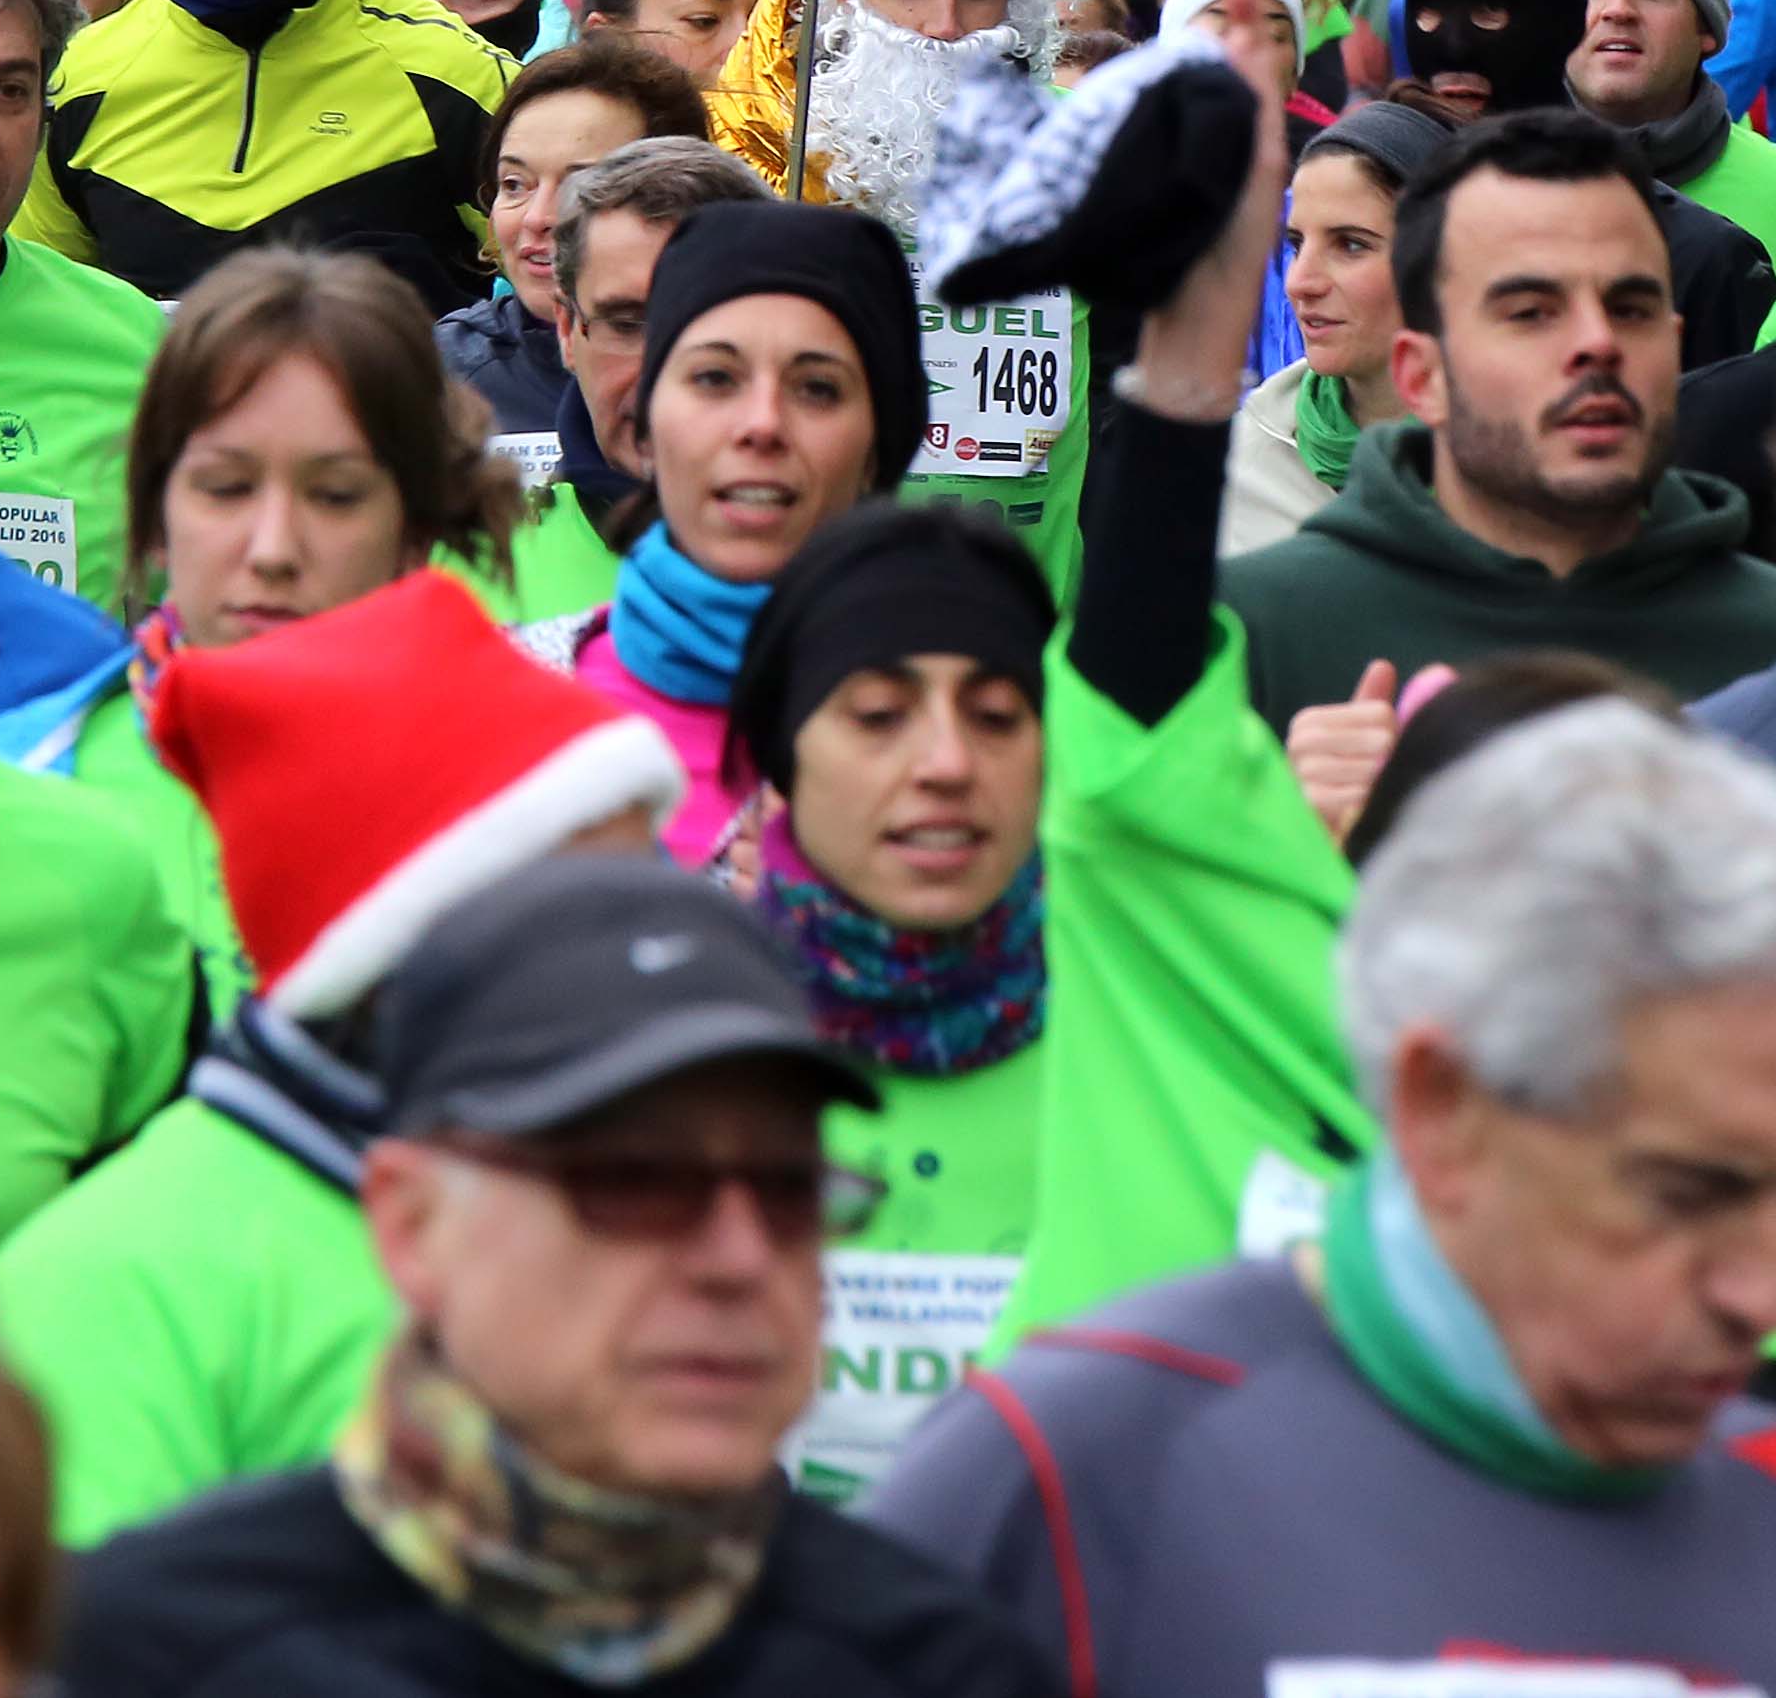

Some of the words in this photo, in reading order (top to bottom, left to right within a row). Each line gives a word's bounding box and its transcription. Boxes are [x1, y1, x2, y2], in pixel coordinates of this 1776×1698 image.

[973, 346, 1058, 417] 1468
[931, 425, 945, 447] 8
[30, 528, 67, 545] 2016
